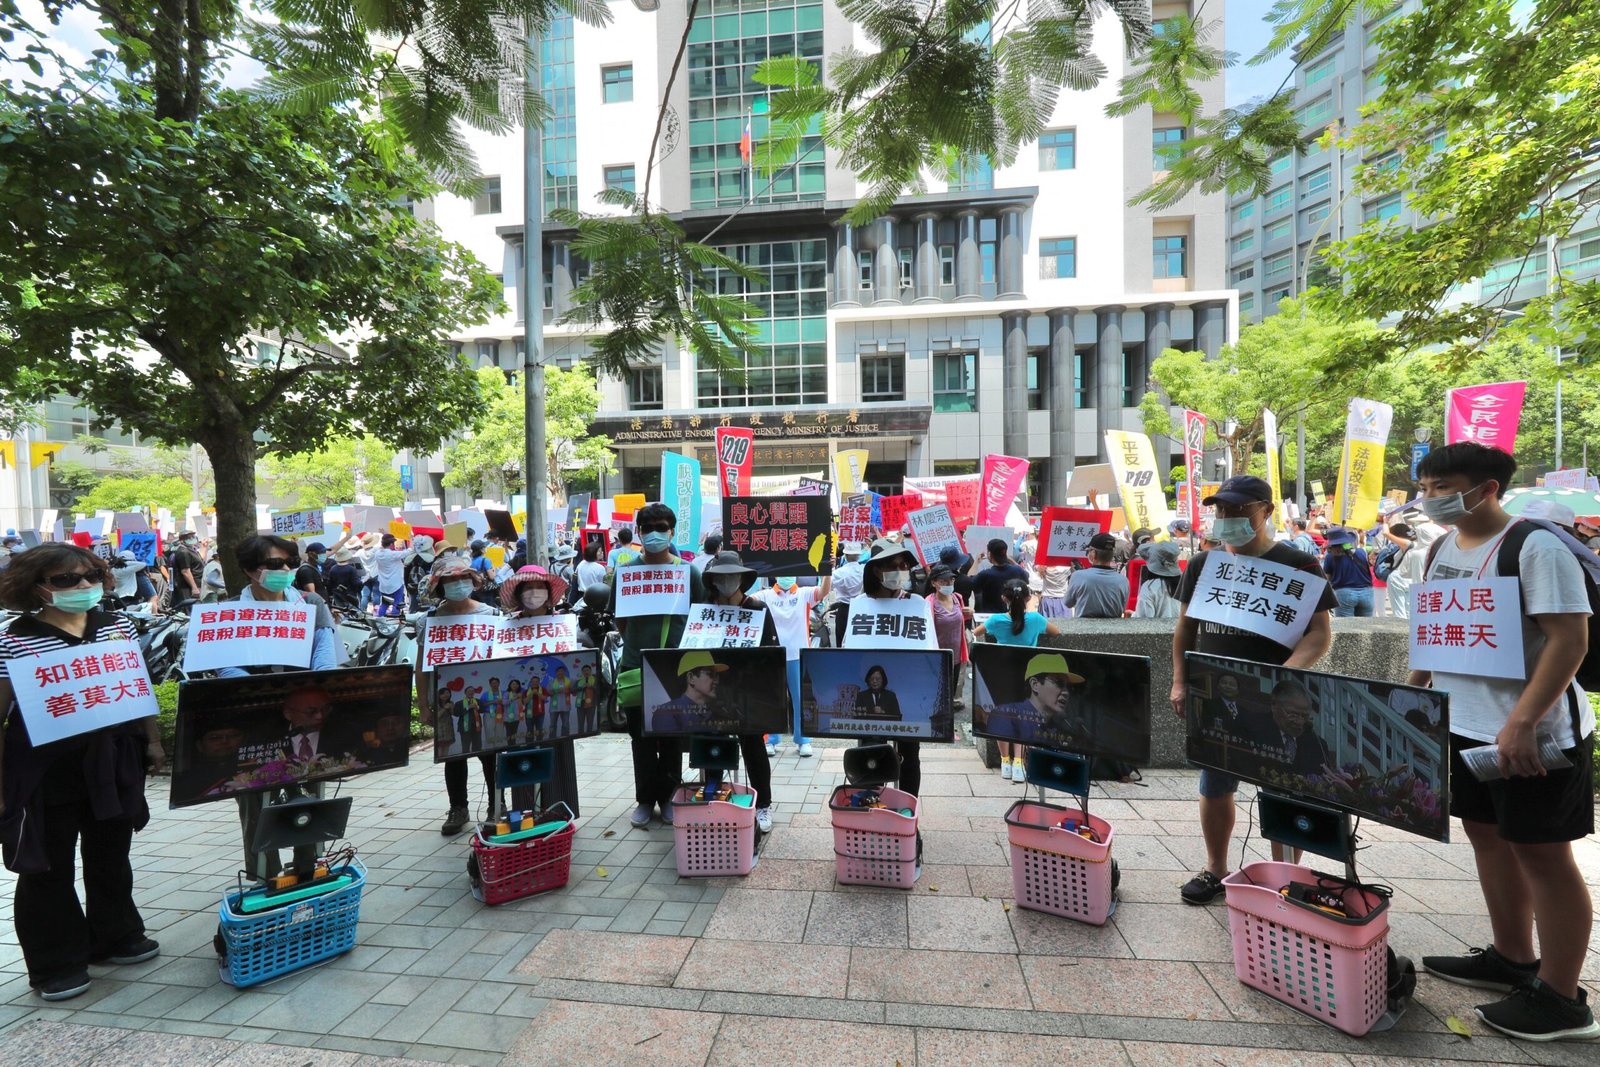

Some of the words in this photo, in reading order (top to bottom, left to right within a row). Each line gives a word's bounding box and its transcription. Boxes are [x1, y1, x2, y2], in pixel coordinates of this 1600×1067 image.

[615, 431, 682, 440] ADMINISTRATIVE
[752, 427, 785, 436] GENCY,
[787, 426, 828, 435] MINISTRY
[831, 425, 842, 433] OF
[844, 424, 879, 433] JUSTICE
[1459, 394, 1508, 446] 全民拒
[721, 435, 749, 465] 1219
[730, 502, 808, 525] 良心覺醒
[912, 508, 949, 528] 林慶宗
[730, 528, 808, 551] 平反假案
[1216, 562, 1305, 600] 犯法官員
[1205, 587, 1297, 626] 天理公審
[1417, 588, 1495, 613] 迫害人民
[201, 608, 307, 624] 官員違法造假
[700, 608, 753, 624] 執行署
[851, 613, 927, 640] 告到底
[197, 626, 307, 642] 假稅單真搶錢
[497, 623, 573, 644] 強奪民產
[1417, 623, 1497, 649] 無法無天
[35, 650, 141, 687] 知錯能改
[44, 677, 150, 718] 善莫大焉
